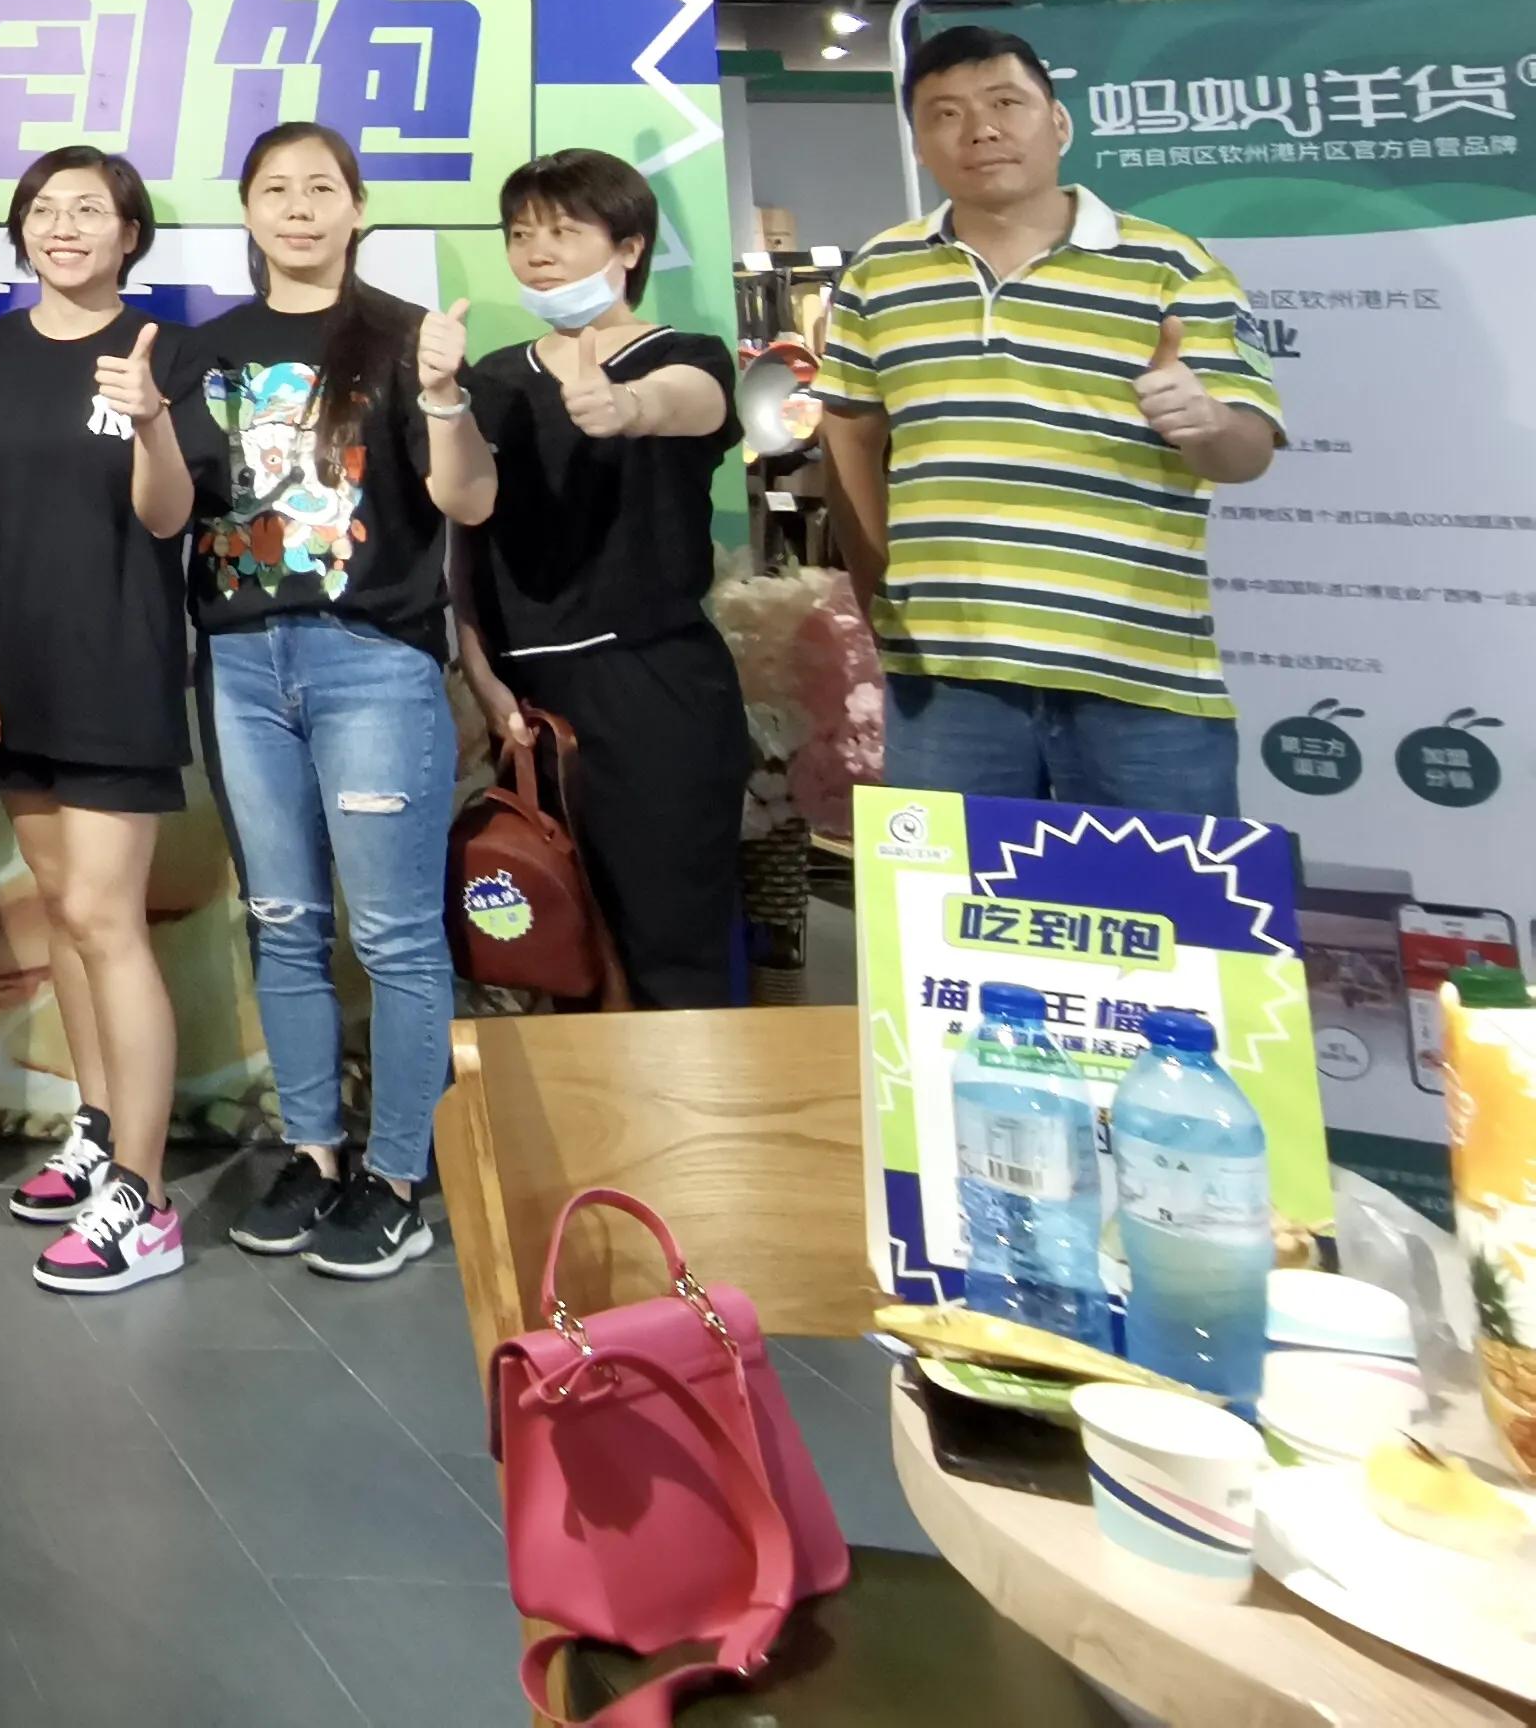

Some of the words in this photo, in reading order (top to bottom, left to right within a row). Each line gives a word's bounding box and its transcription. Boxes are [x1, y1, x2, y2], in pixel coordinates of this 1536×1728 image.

[1089, 63, 1517, 138] 蚂蚁洋货
[958, 902, 1161, 962] 吃到饱
